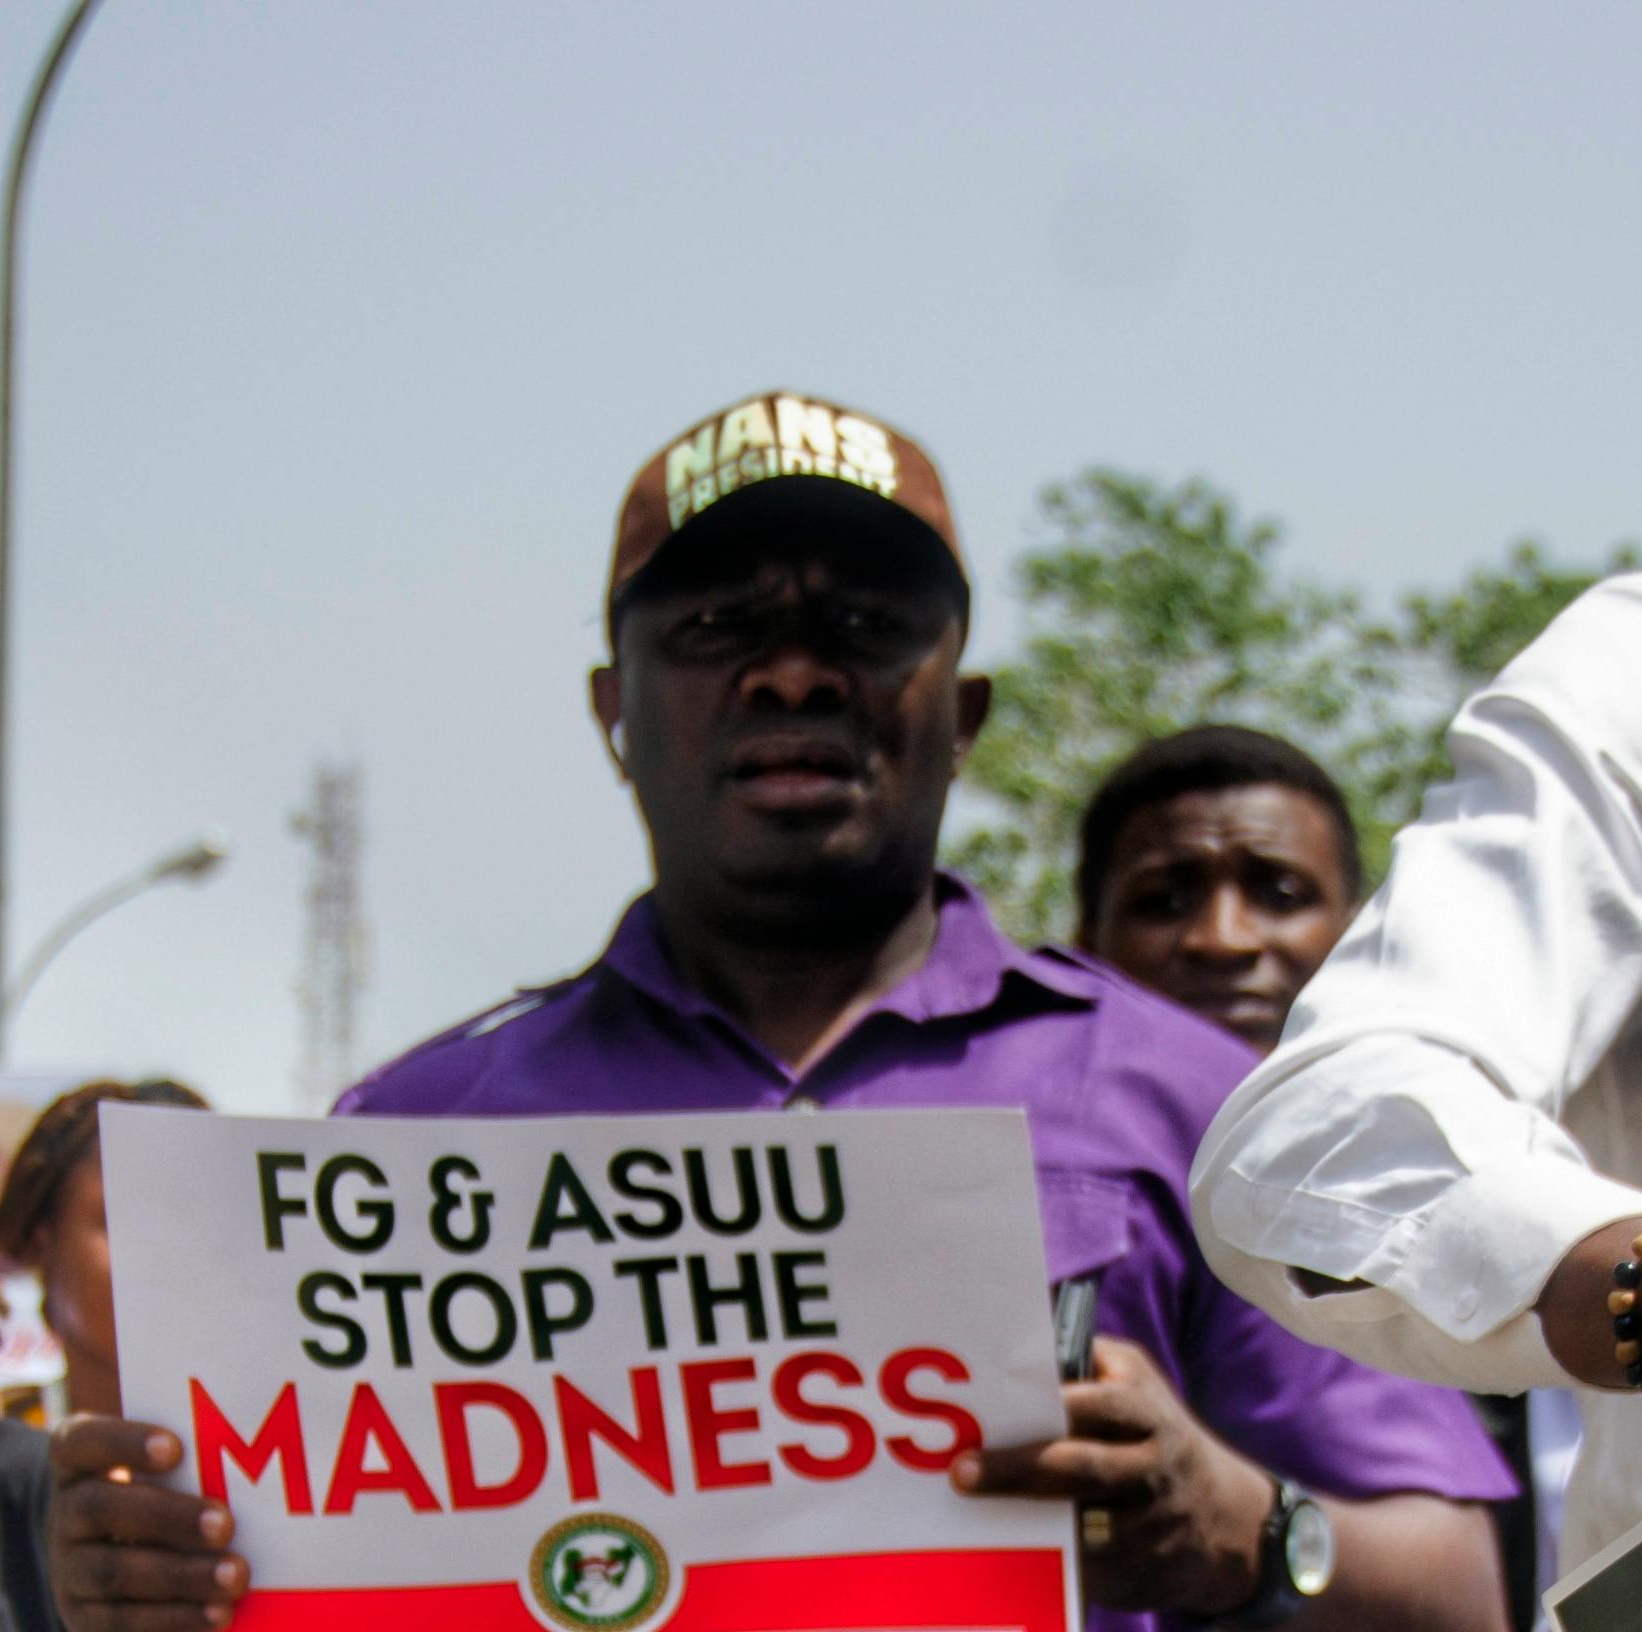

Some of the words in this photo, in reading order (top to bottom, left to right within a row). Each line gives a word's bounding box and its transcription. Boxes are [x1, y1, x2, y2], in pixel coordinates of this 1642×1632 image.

[666, 396, 896, 496] NANS
[255, 1149, 397, 1255] FG
[427, 1154, 495, 1255] &
[526, 1143, 849, 1253] ASUU
[295, 1266, 596, 1369] STOP
[612, 1249, 839, 1351] THE
[188, 1346, 985, 1518] MADNESS
